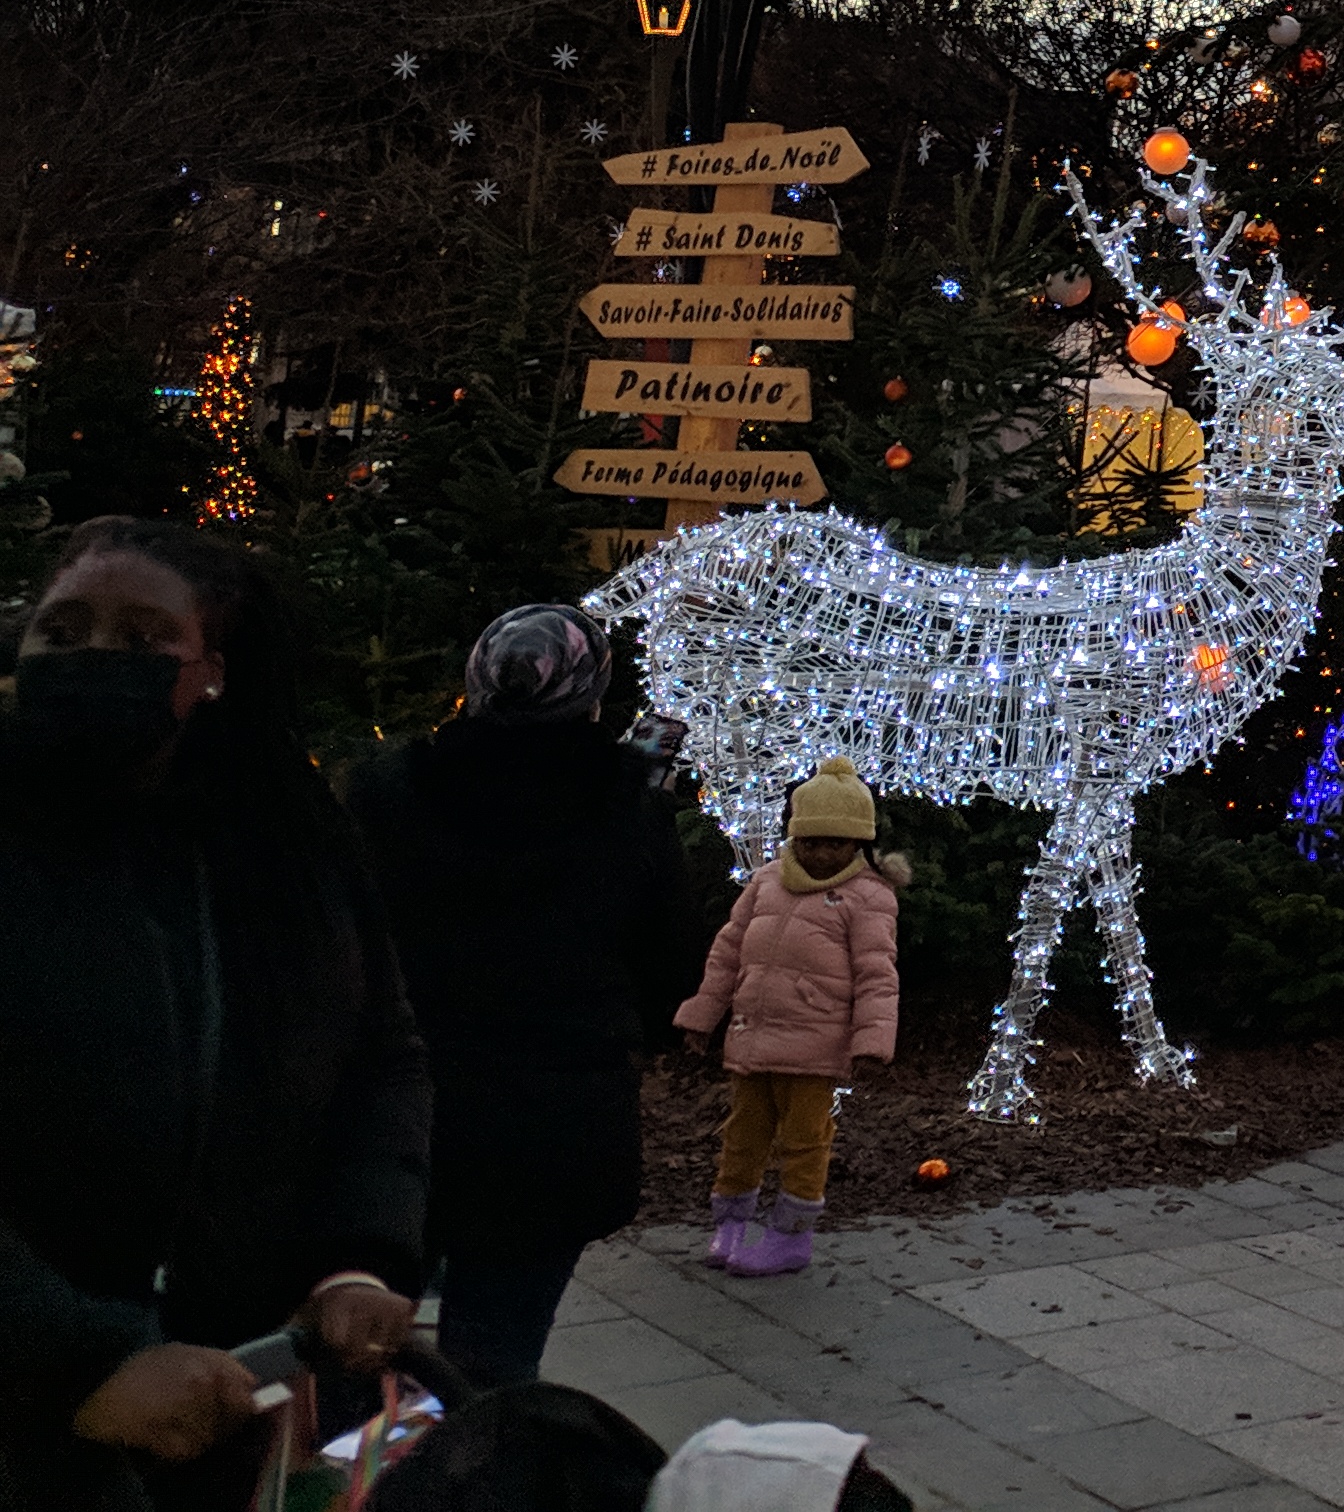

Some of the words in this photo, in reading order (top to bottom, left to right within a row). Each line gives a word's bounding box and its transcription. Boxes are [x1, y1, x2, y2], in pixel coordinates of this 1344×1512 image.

[662, 223, 724, 251] Saint
[734, 223, 805, 252] Denis
[615, 369, 785, 404] Patinoire
[581, 459, 645, 486] Ferme
[652, 459, 804, 493] Pédagogique
